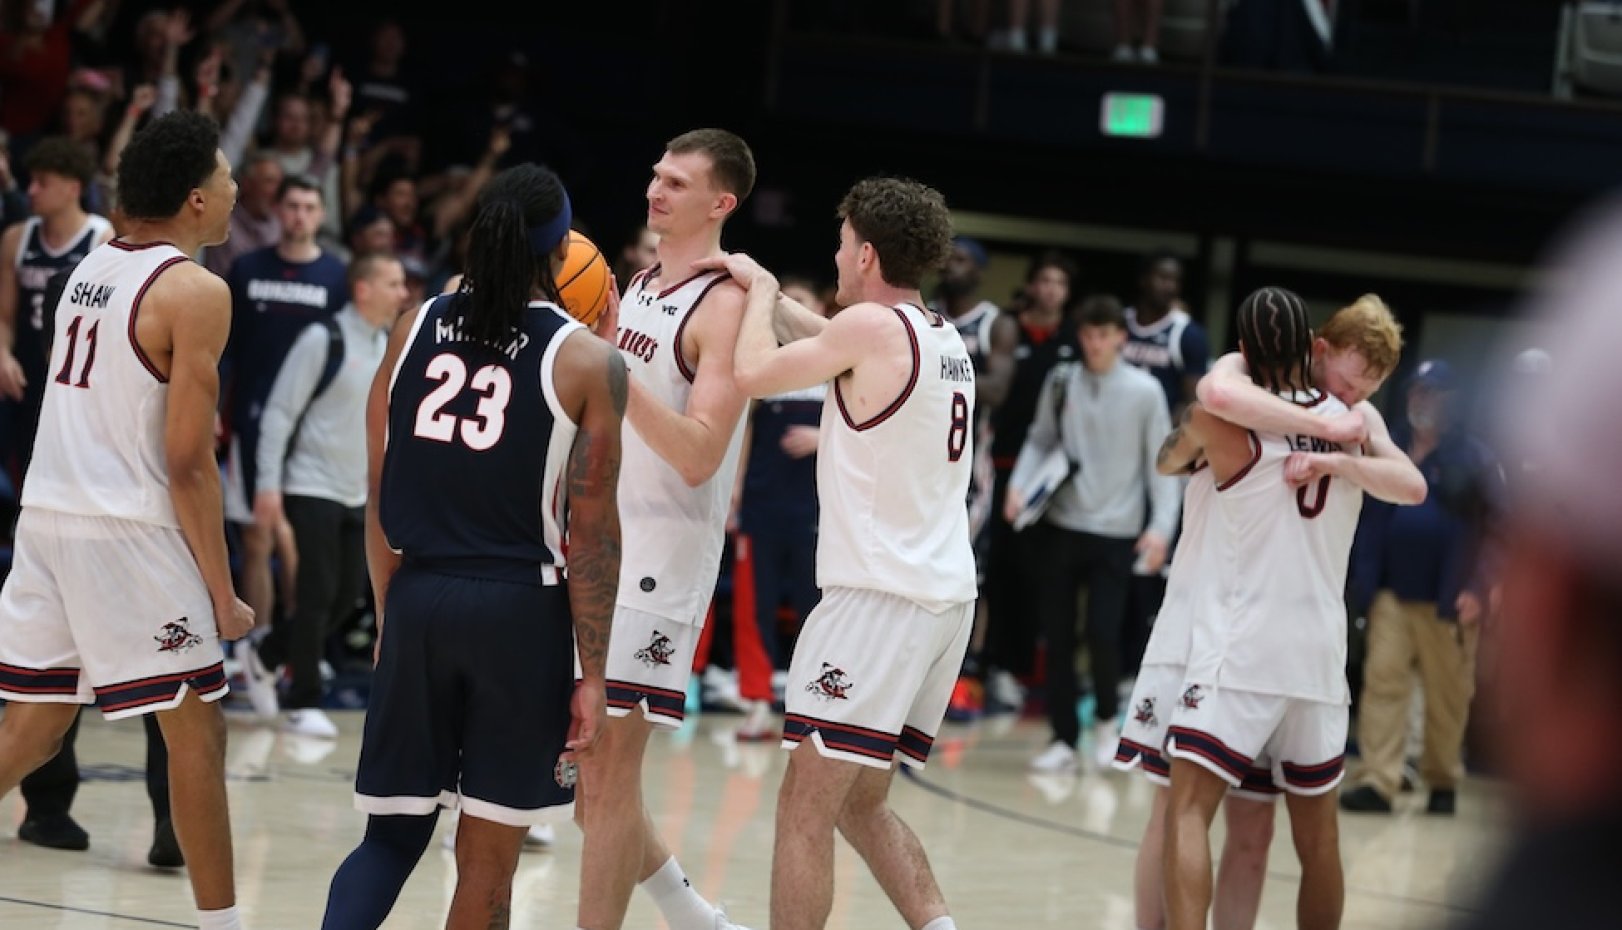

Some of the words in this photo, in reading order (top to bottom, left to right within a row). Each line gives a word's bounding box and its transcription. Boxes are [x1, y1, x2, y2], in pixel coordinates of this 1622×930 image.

[71, 282, 116, 308] SHAW
[55, 315, 101, 389] 11
[413, 352, 513, 452] 23
[948, 391, 969, 463] 8
